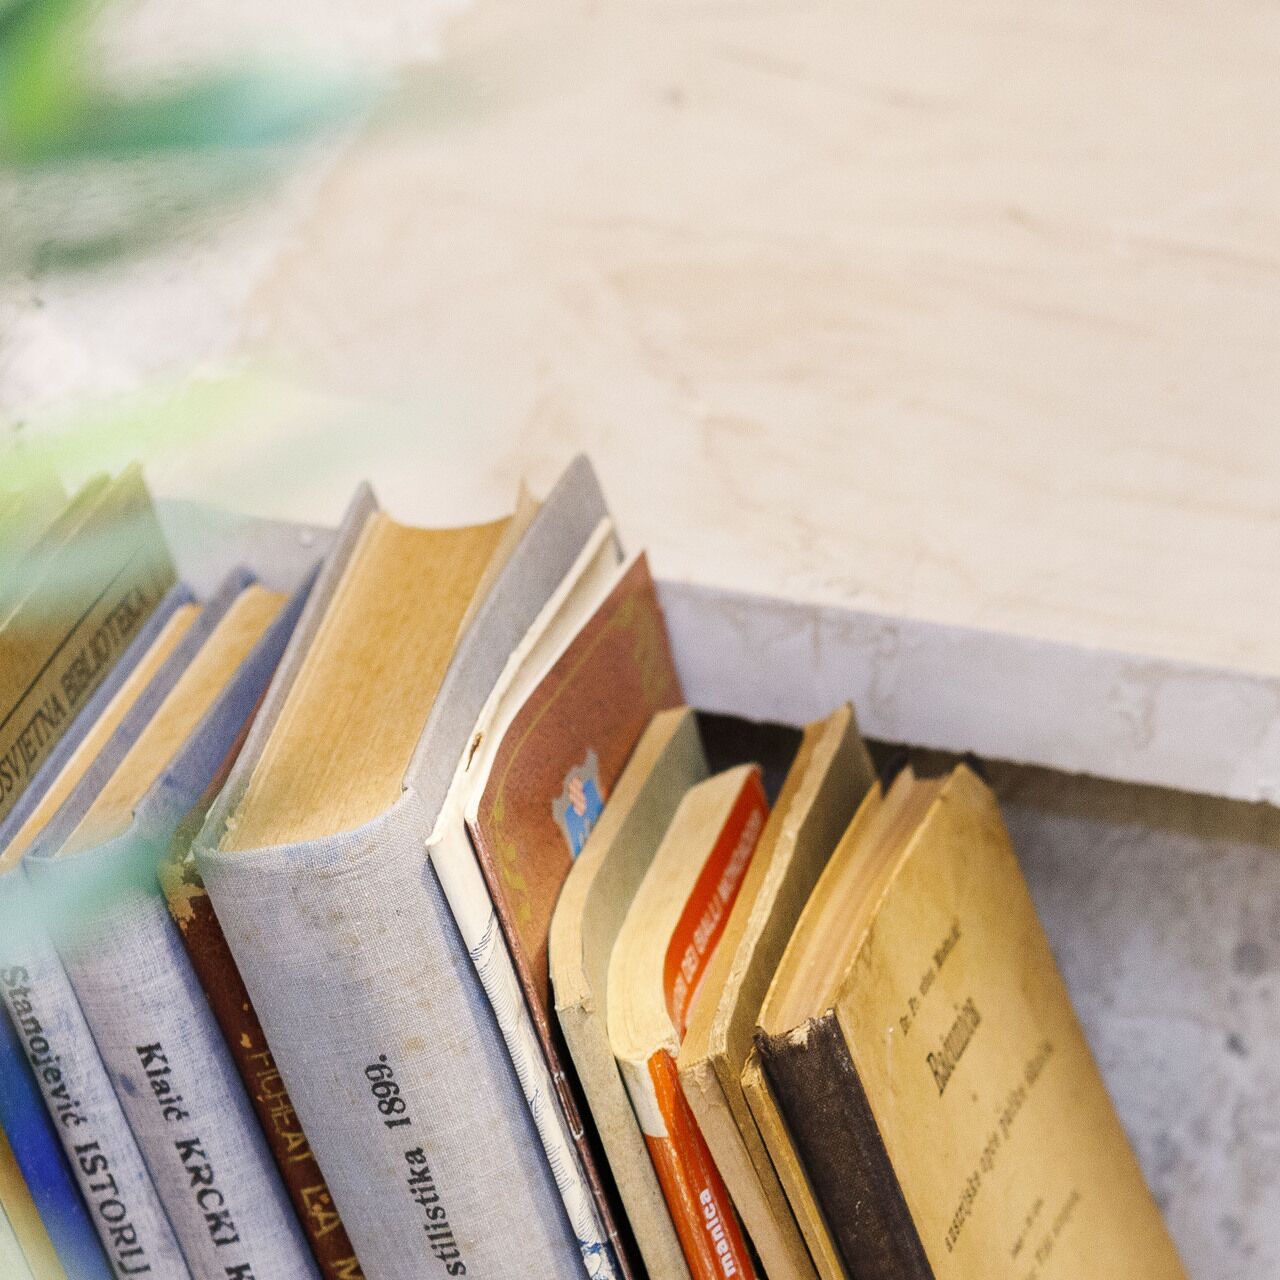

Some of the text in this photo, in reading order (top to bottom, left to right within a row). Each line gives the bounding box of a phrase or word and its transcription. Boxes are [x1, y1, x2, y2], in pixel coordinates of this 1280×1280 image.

[0, 963, 86, 1127] Stanojević
[364, 1053, 412, 1129] 1899.
[135, 1041, 190, 1123] Klaić
[173, 1136, 241, 1248] KRCKI
[404, 1145, 468, 1277] stilistika
[699, 1186, 739, 1278] manica
